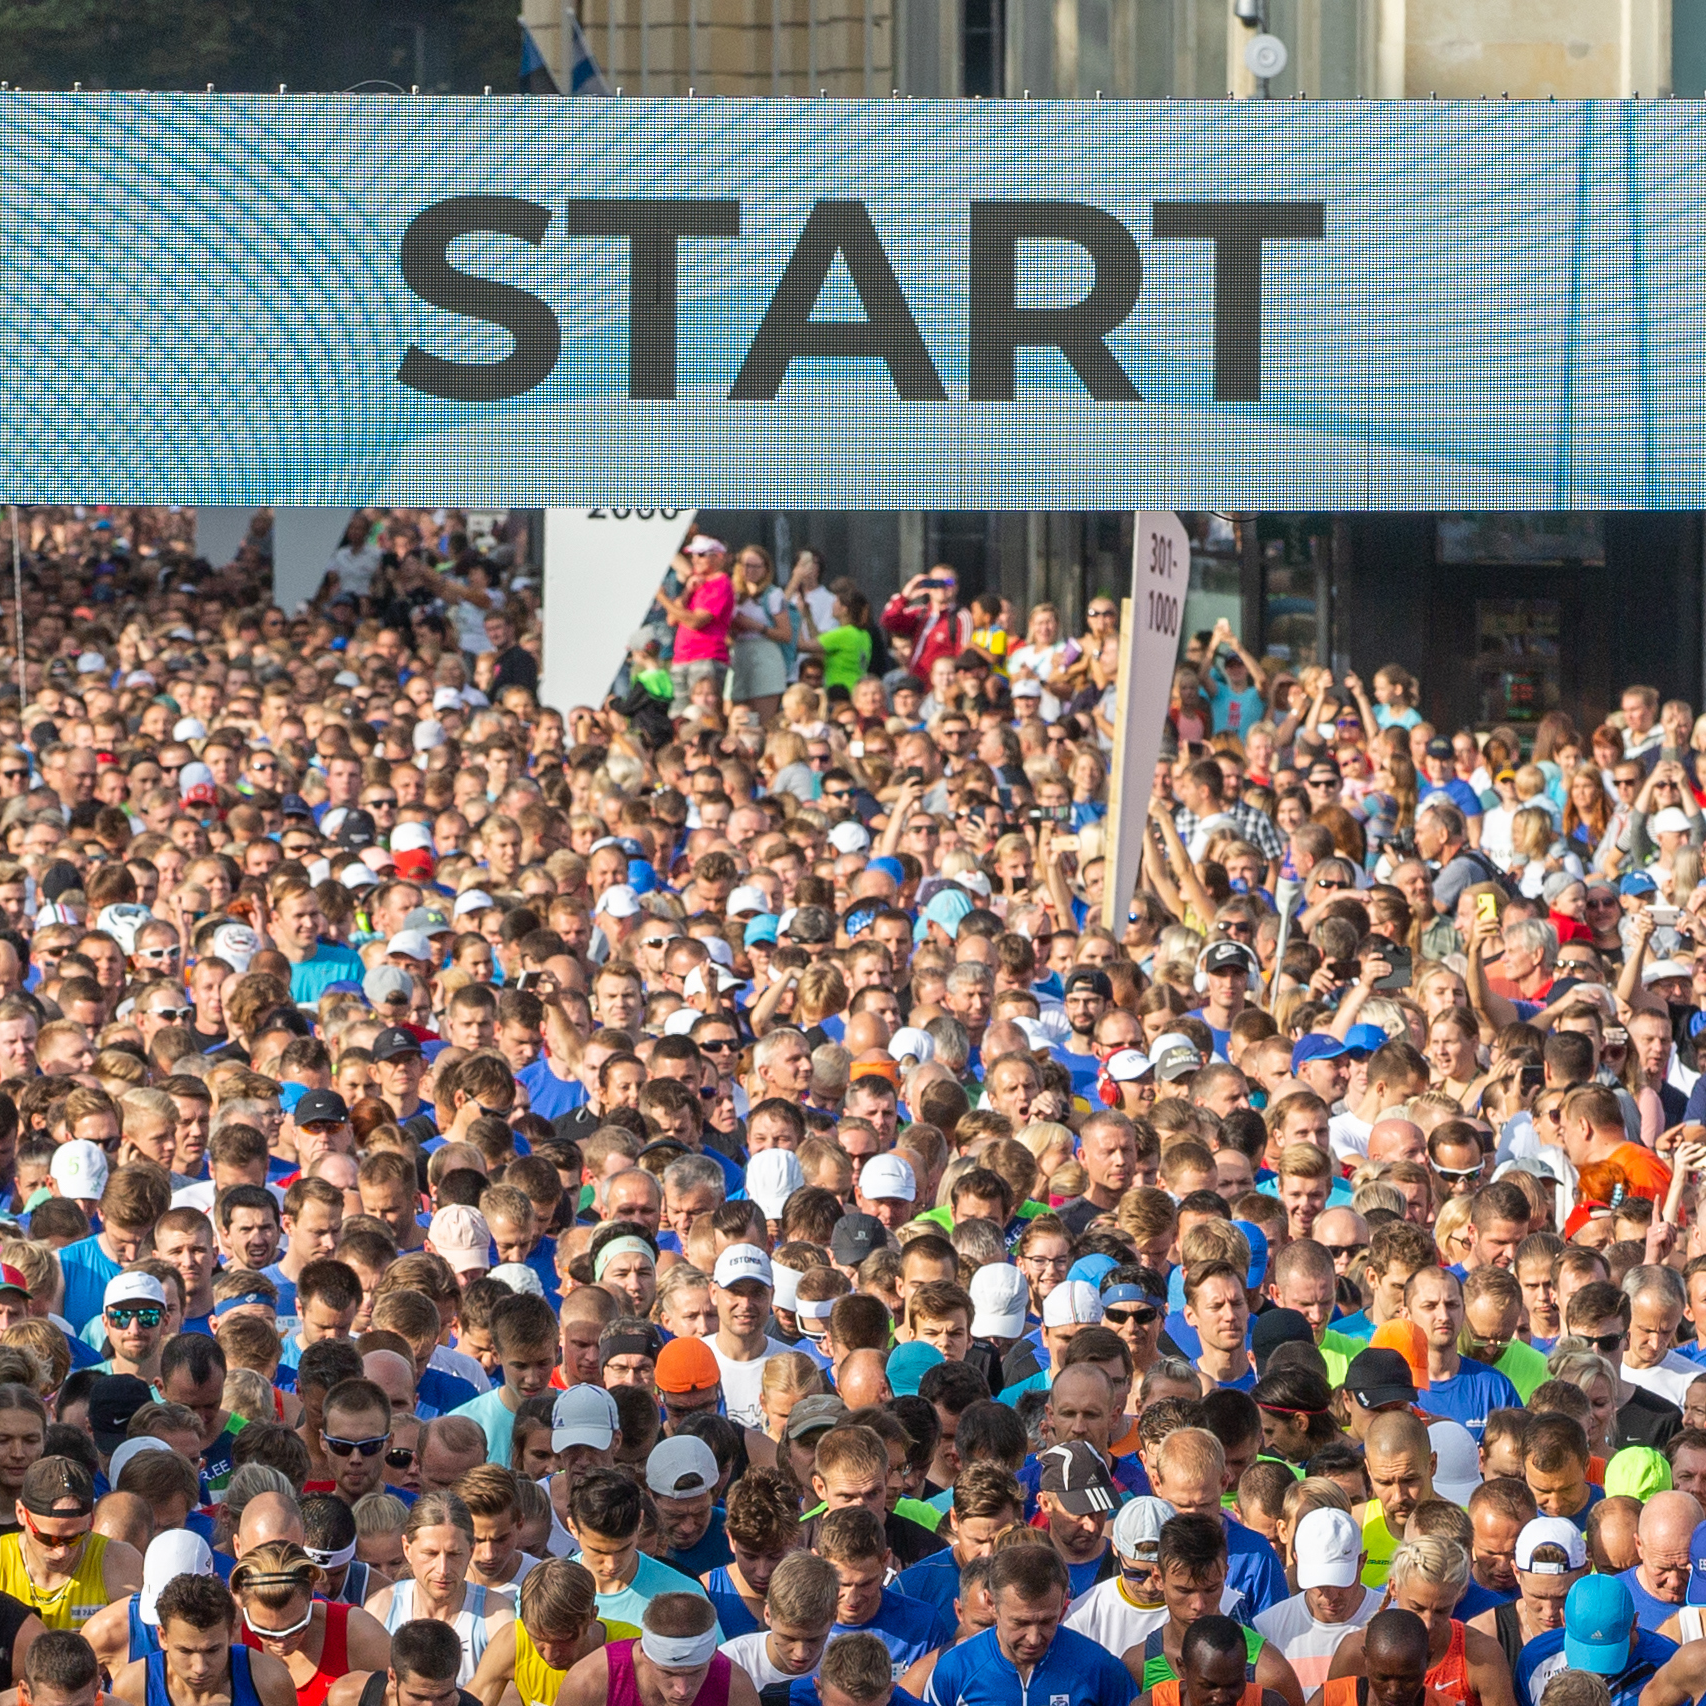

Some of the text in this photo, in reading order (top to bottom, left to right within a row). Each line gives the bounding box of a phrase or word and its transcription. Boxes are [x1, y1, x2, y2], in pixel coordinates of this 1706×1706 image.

[396, 195, 1326, 403] START
[1149, 531, 1179, 578] 301-
[1148, 589, 1179, 638] 1000
[729, 1256, 769, 1267] ESTONIA
